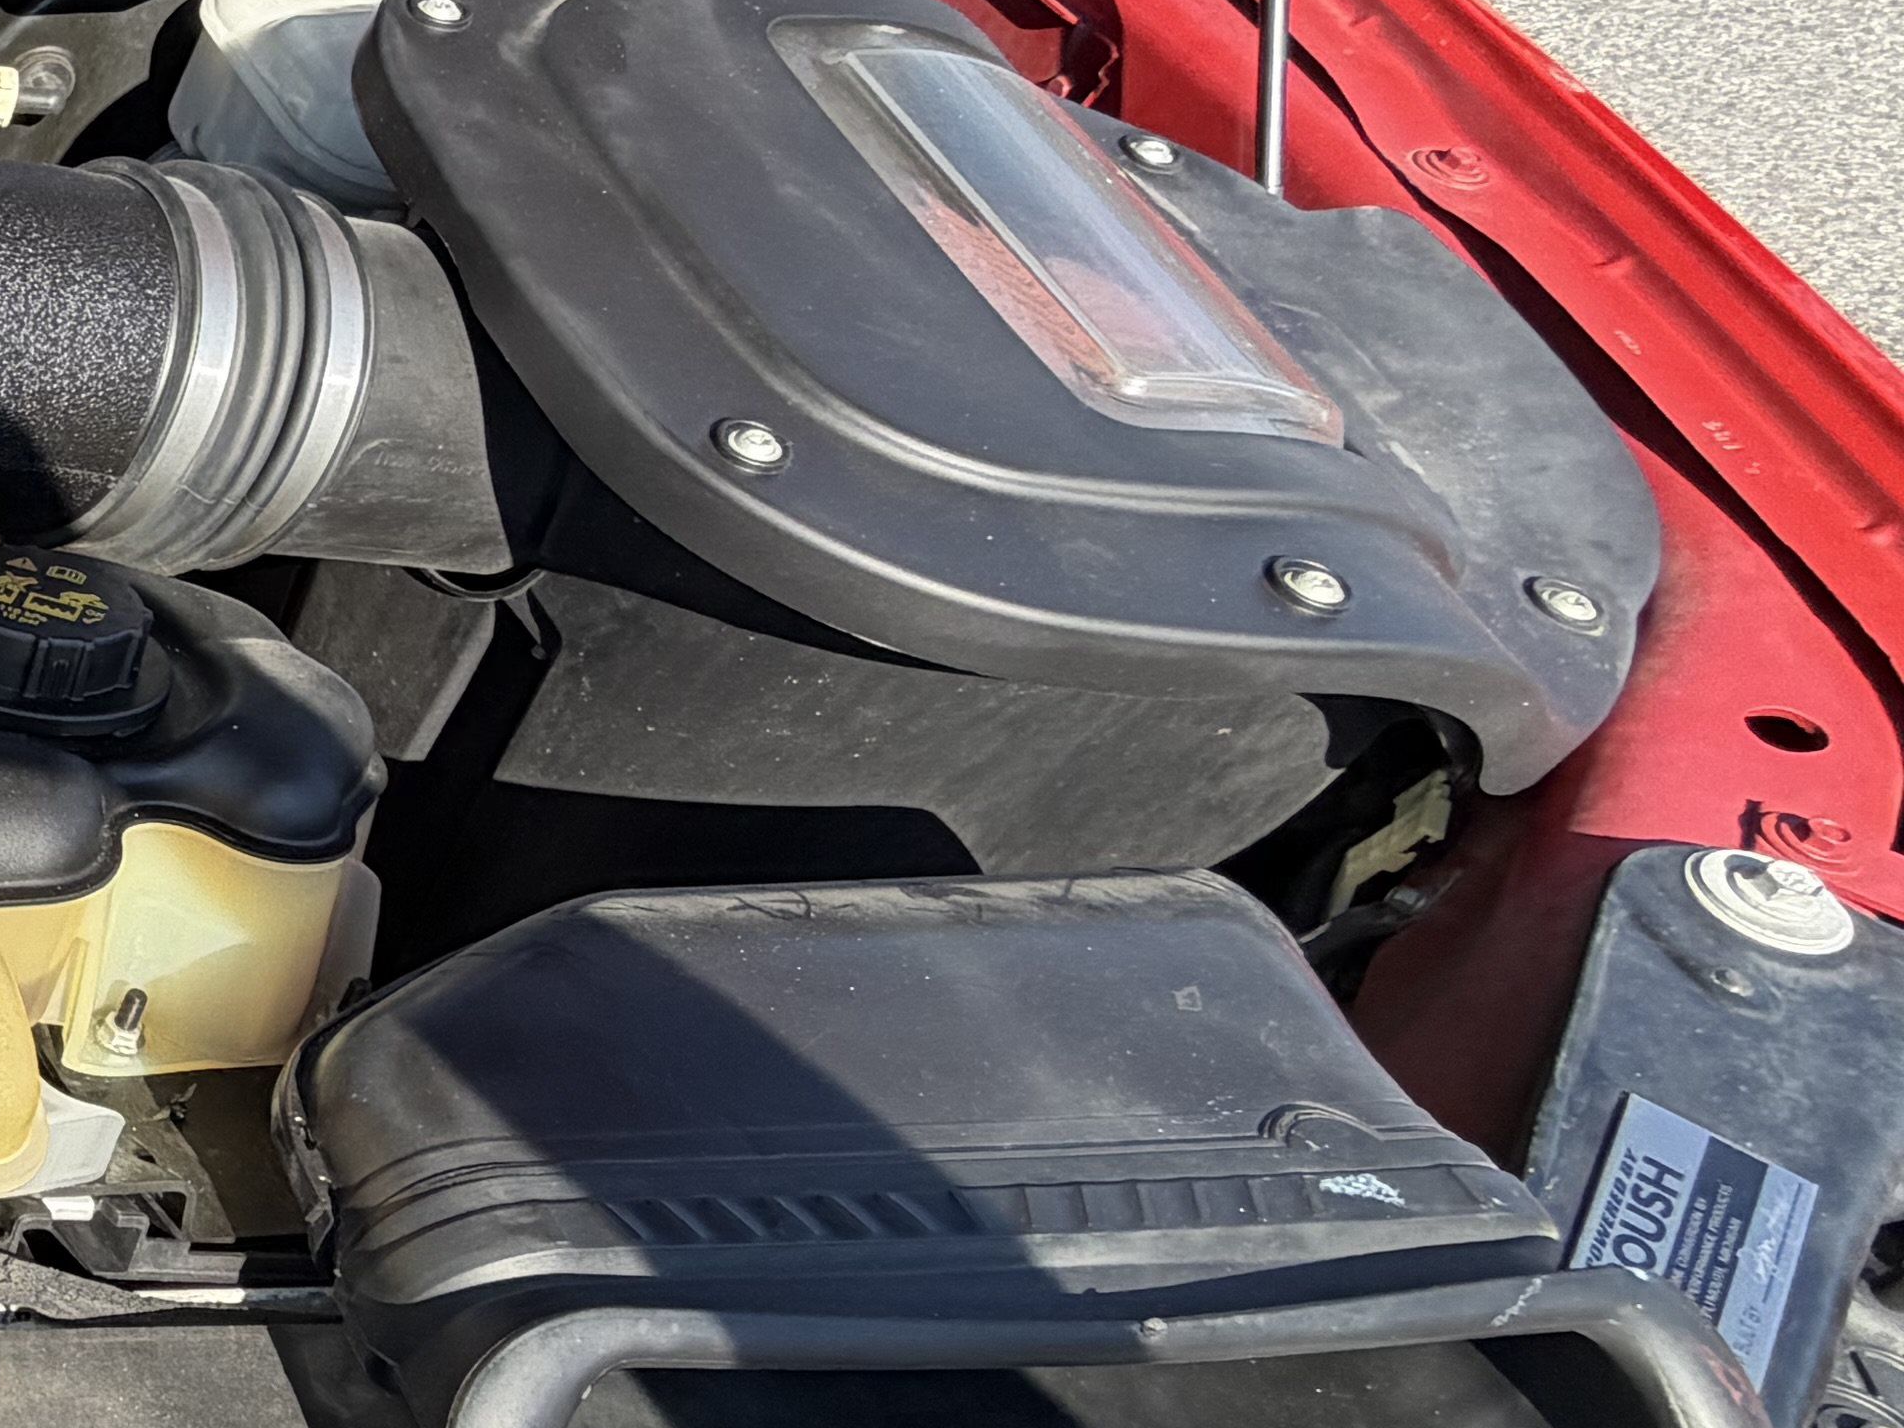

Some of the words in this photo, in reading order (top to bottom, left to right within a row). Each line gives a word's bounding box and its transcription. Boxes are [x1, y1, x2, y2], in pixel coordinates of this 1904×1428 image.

[1585, 1176, 1629, 1269] POWERED
[1620, 1147, 1639, 1177] BY
[1612, 1155, 1686, 1271] OUSH
